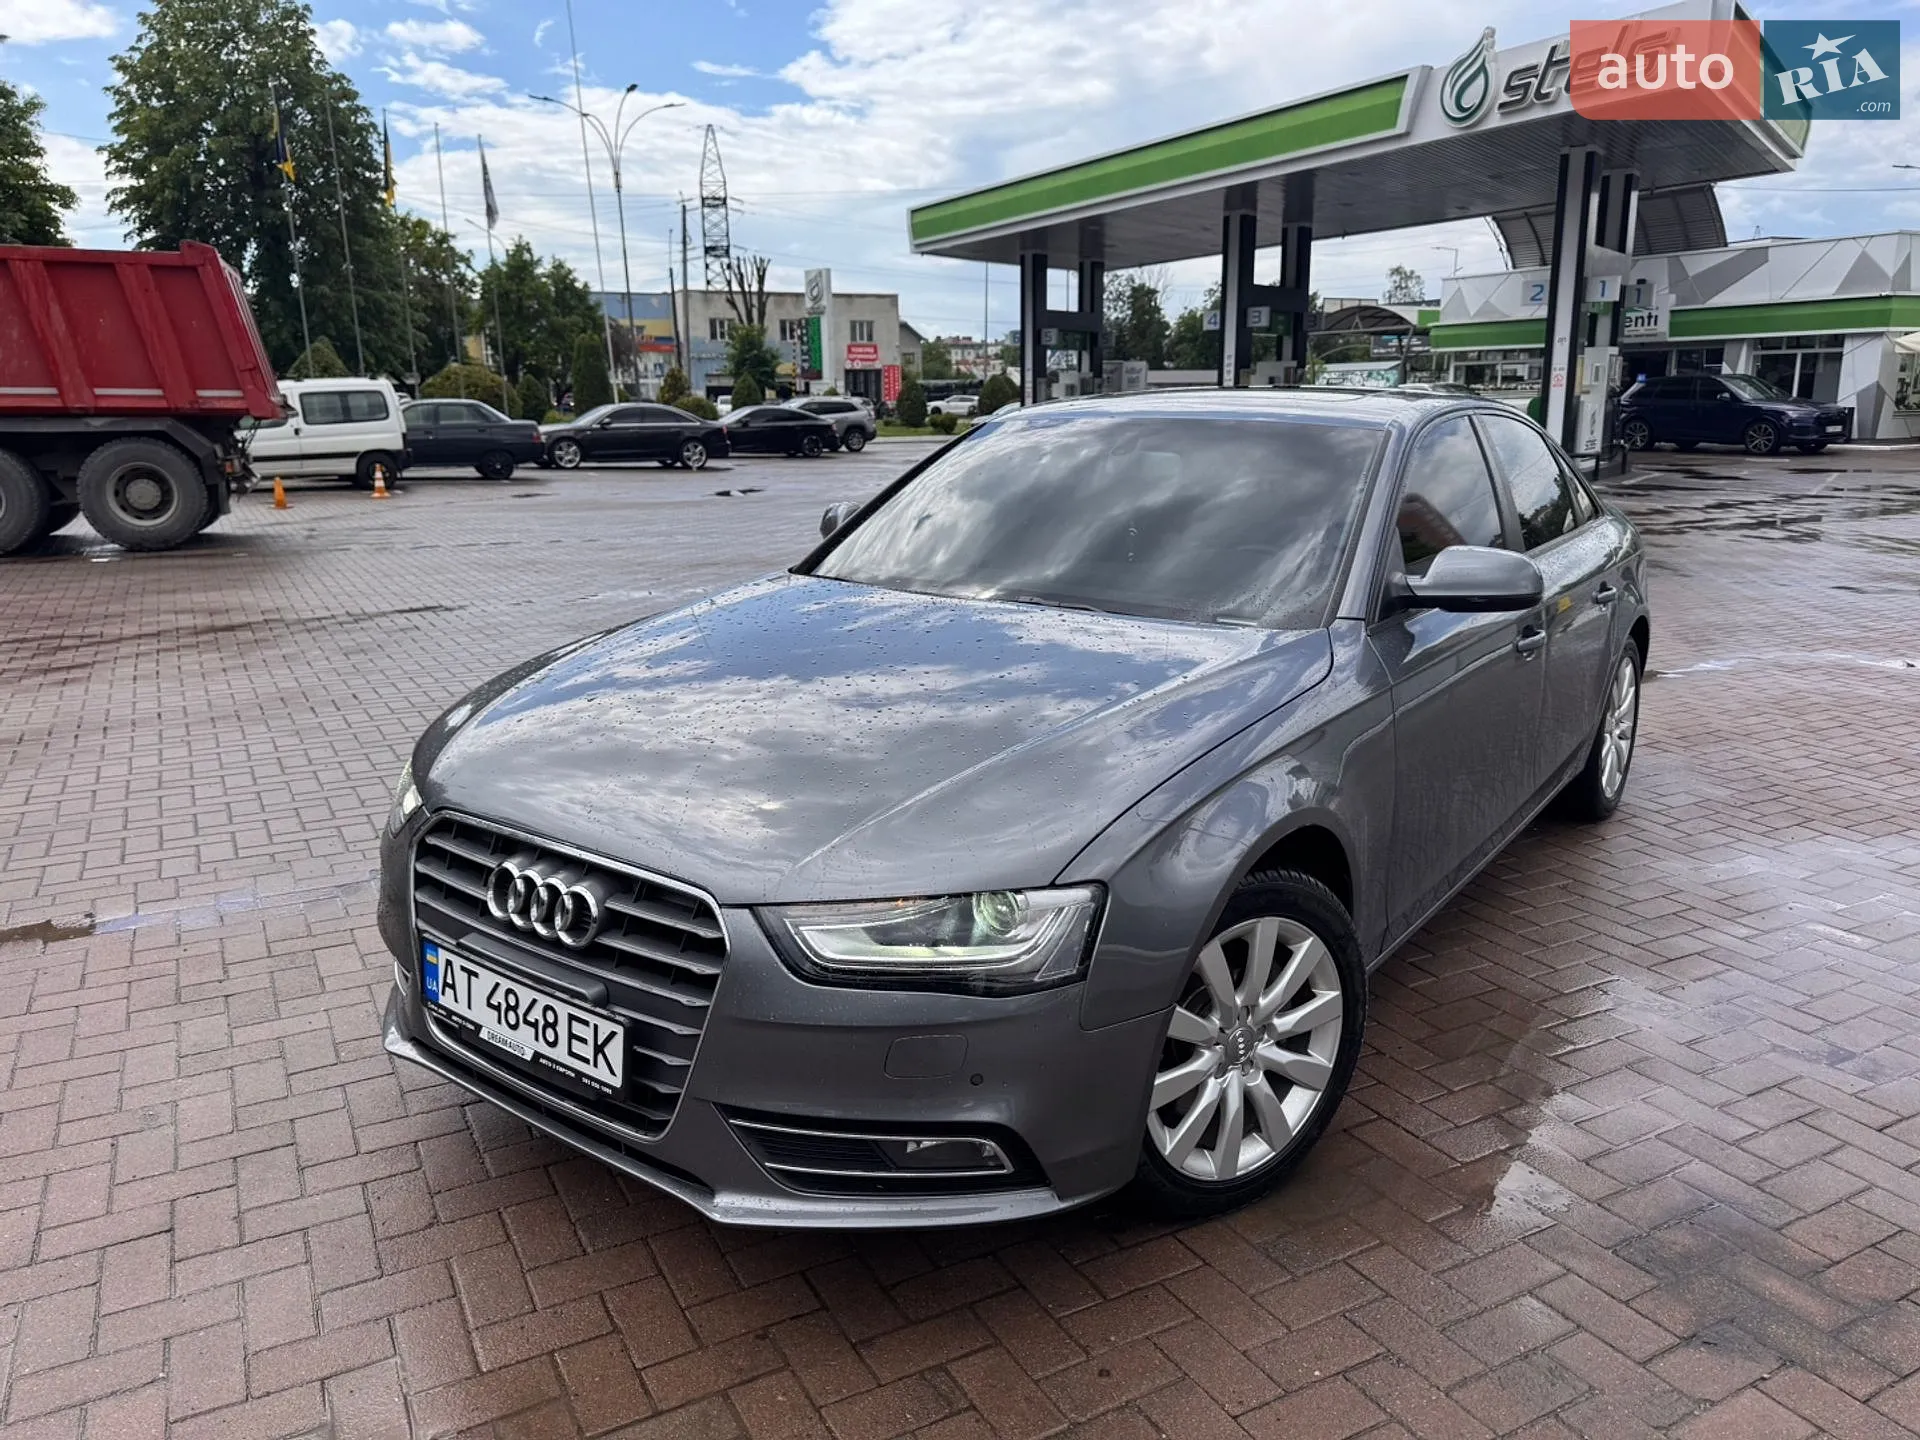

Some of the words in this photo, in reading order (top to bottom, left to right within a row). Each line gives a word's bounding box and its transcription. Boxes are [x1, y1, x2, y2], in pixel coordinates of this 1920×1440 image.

[1529, 284, 1545, 302] 2
[1599, 280, 1607, 298] 1
[1207, 313, 1219, 328] 4
[1252, 311, 1263, 325] 3
[426, 975, 439, 993] UA
[441, 958, 480, 1010] AT
[486, 982, 559, 1049] 4848
[567, 1012, 618, 1078] EK
